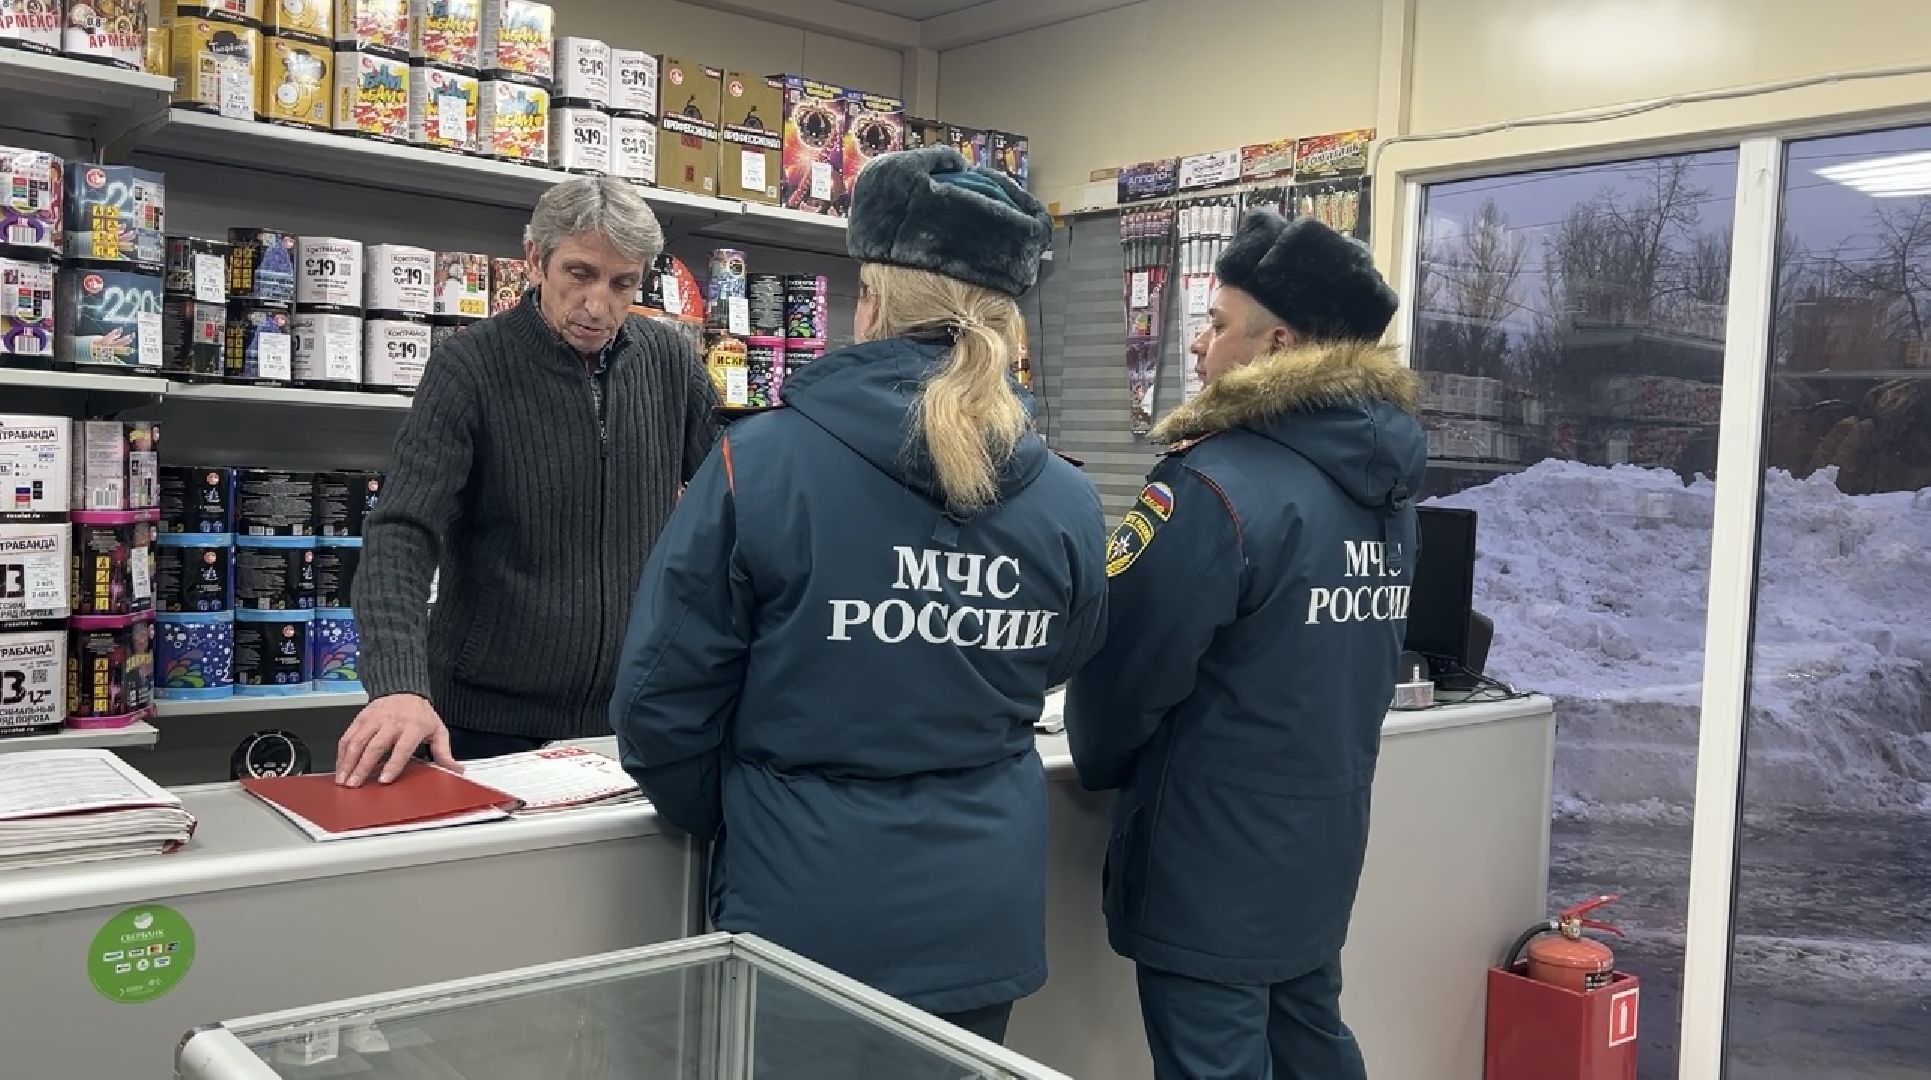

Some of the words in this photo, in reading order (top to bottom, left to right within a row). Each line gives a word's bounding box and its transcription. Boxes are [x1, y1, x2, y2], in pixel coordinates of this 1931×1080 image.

[891, 546, 1020, 600] МЧС
[0, 643, 51, 658] РАБАНДА
[827, 599, 1059, 651] РОССИИ
